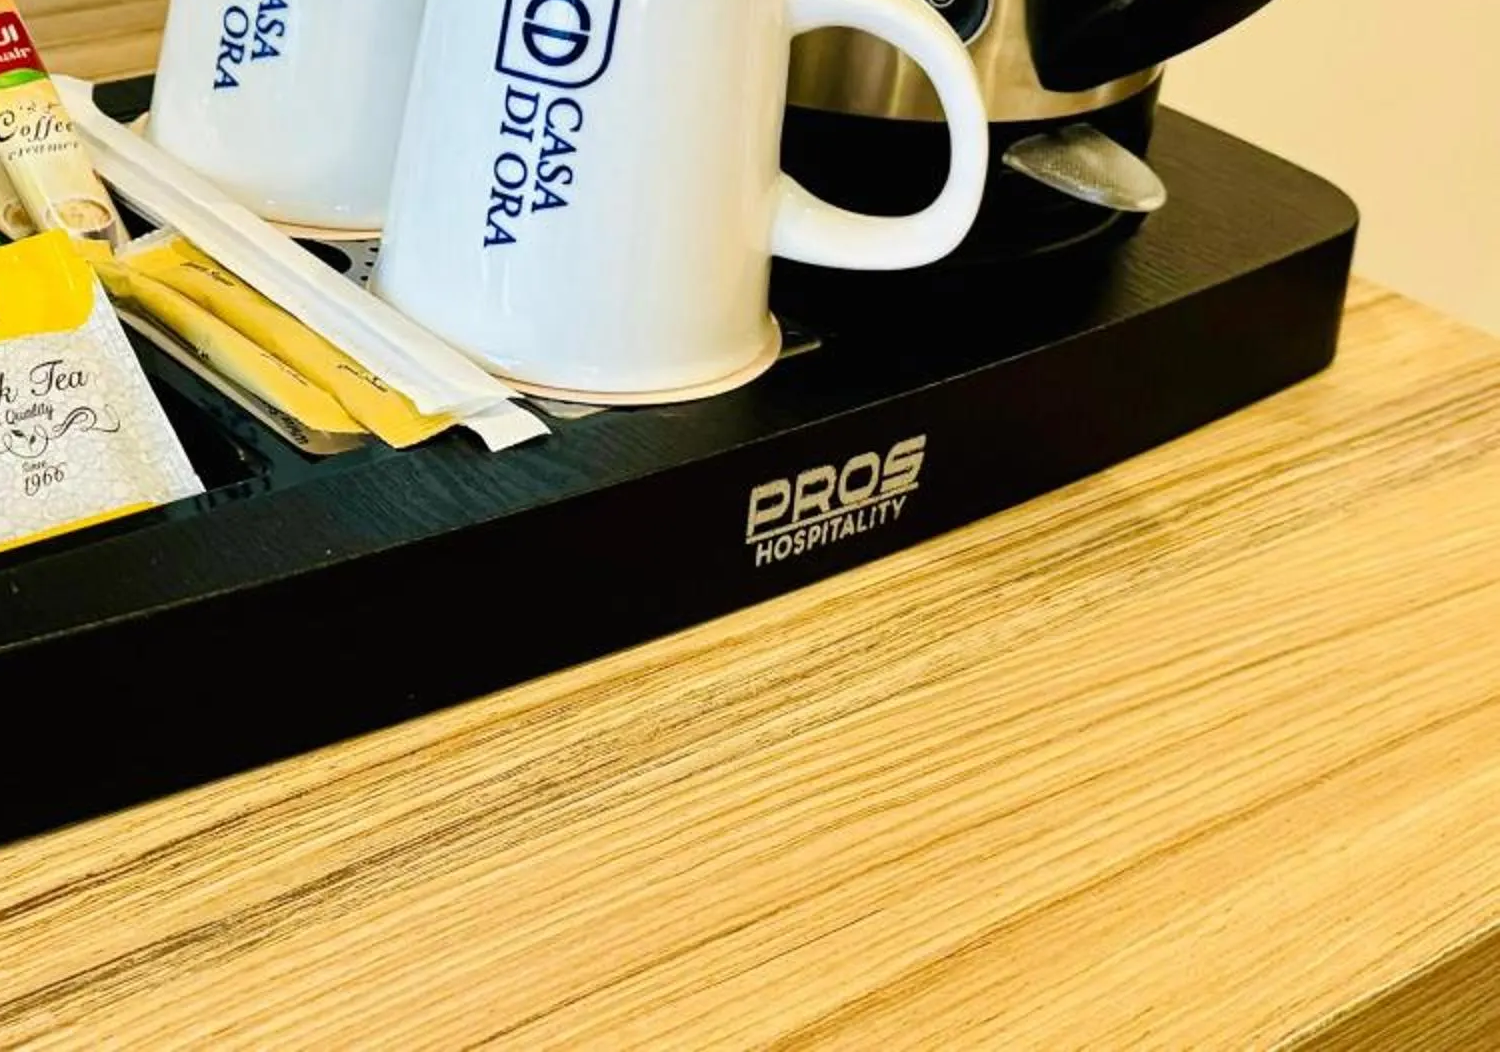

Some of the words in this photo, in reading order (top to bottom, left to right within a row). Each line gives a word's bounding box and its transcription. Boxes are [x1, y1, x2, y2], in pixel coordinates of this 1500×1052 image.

[213, 5, 249, 90] ORA
[500, 84, 540, 142] DI
[531, 97, 583, 212] CASA
[483, 152, 528, 248] ORA
[5, 402, 54, 424] Quality
[29, 359, 88, 397] Tea
[25, 463, 68, 497] 1966
[746, 434, 926, 543] PROS
[755, 495, 907, 568] HOSPITALITY
